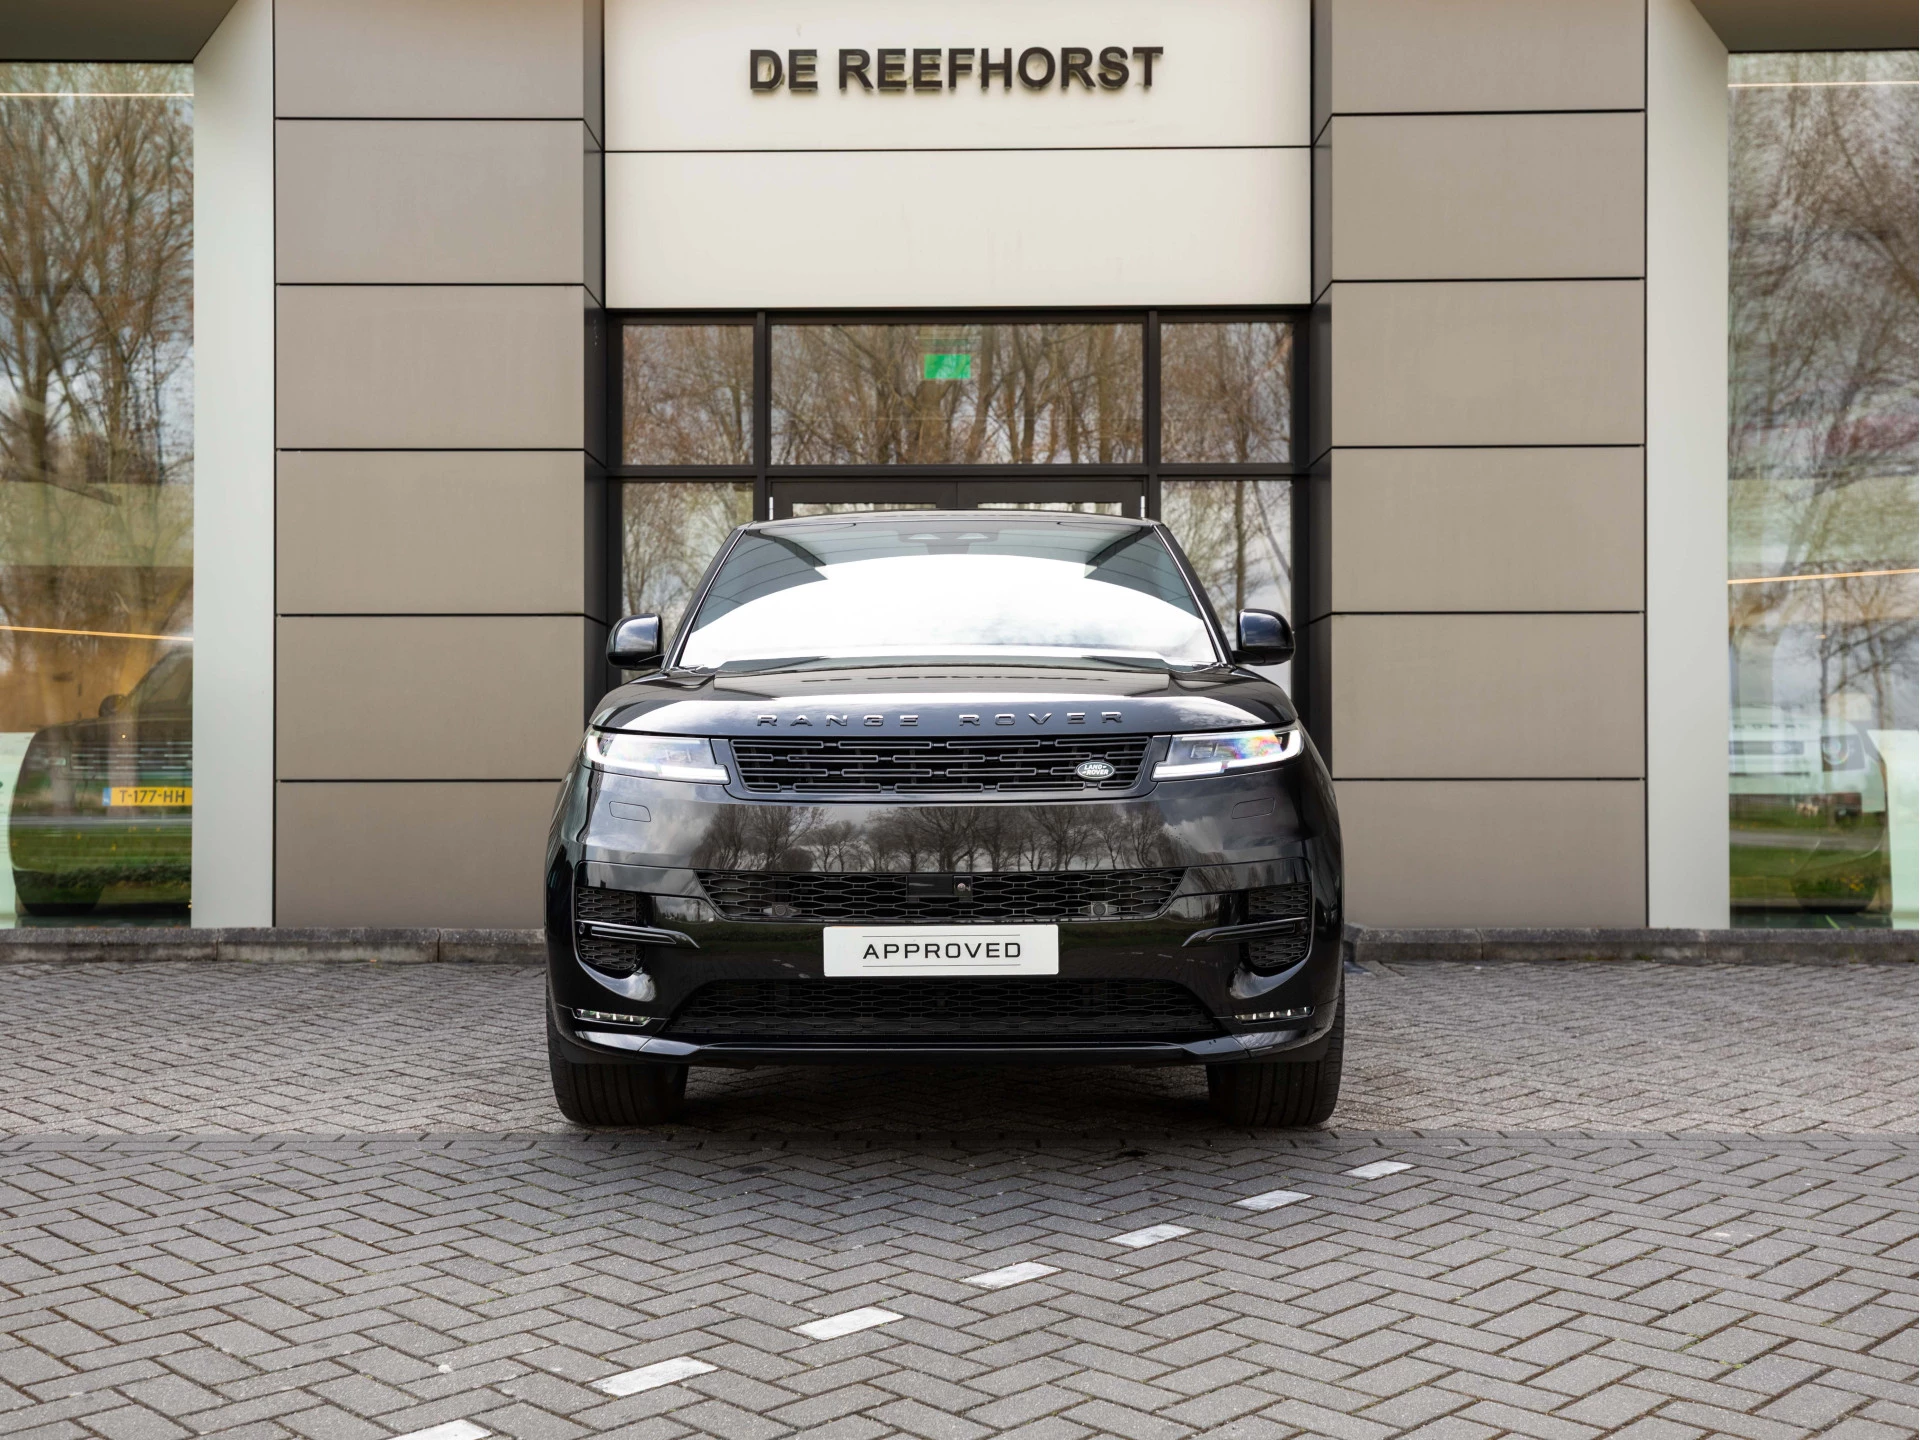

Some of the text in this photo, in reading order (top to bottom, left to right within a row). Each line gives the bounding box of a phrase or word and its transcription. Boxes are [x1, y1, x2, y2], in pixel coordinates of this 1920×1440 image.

[749, 46, 1164, 91] DE REEFHORST
[756, 711, 1123, 727] RANGE ROVER
[119, 789, 186, 804] T-177-HH
[862, 942, 1021, 960] APPROVED
